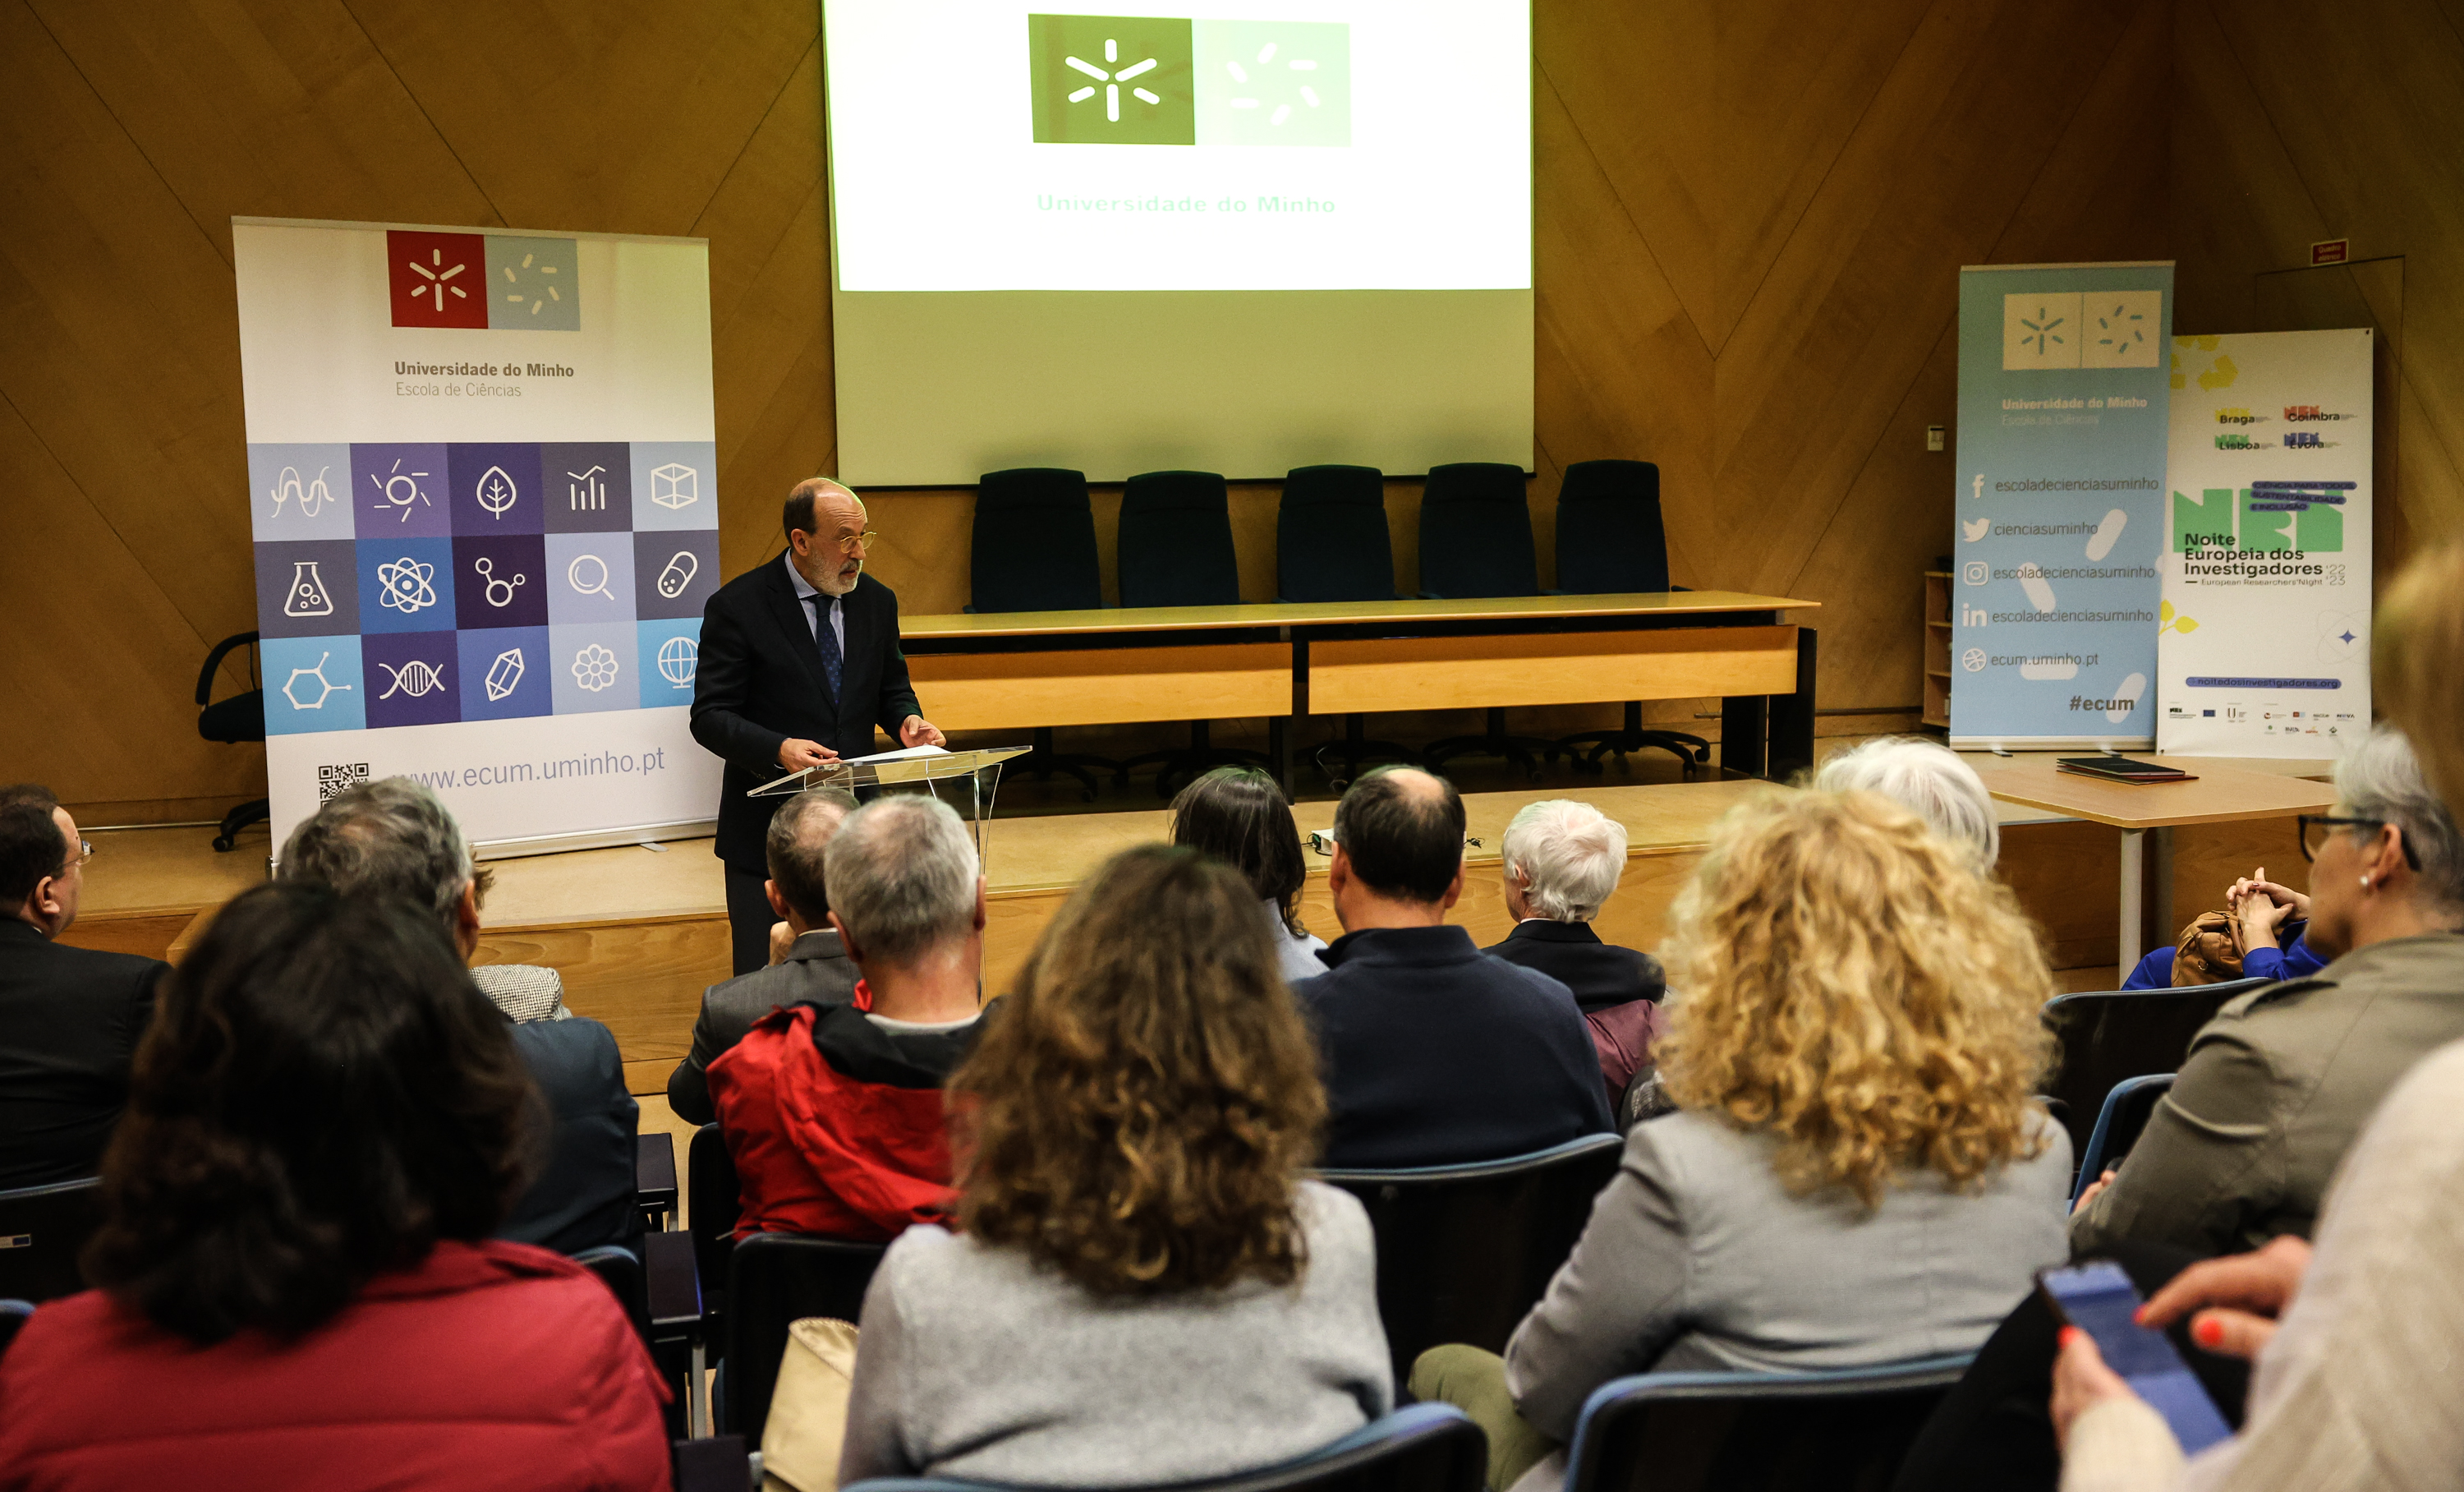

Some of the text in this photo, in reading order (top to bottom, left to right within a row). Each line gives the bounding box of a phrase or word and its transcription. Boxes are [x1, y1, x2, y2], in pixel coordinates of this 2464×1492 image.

[1037, 194, 1335, 213] Universidade do Minho
[394, 361, 575, 378] Universidade do Minho
[396, 381, 522, 398] Escola de Ciências
[2002, 397, 2147, 410] Universidade do Minho
[2220, 415, 2255, 426] Braga
[2288, 412, 2340, 421] Coimbra
[2220, 441, 2260, 449] Lisboa
[1996, 477, 2158, 492] escoladecienciasuminho
[1995, 523, 2099, 536] cienciasuminho
[2185, 533, 2236, 546] Noite
[2185, 548, 2304, 563] Europeia dos
[1993, 566, 2155, 580] escoladecienciasuminho
[2185, 562, 2323, 578] Investigadores
[1993, 609, 2154, 623] escoladecienciasuminho
[1992, 653, 2099, 666] ecum.uminho.pt
[2070, 695, 2135, 711] #ecum
[393, 747, 665, 789] ww.ecum.uminho.pt
